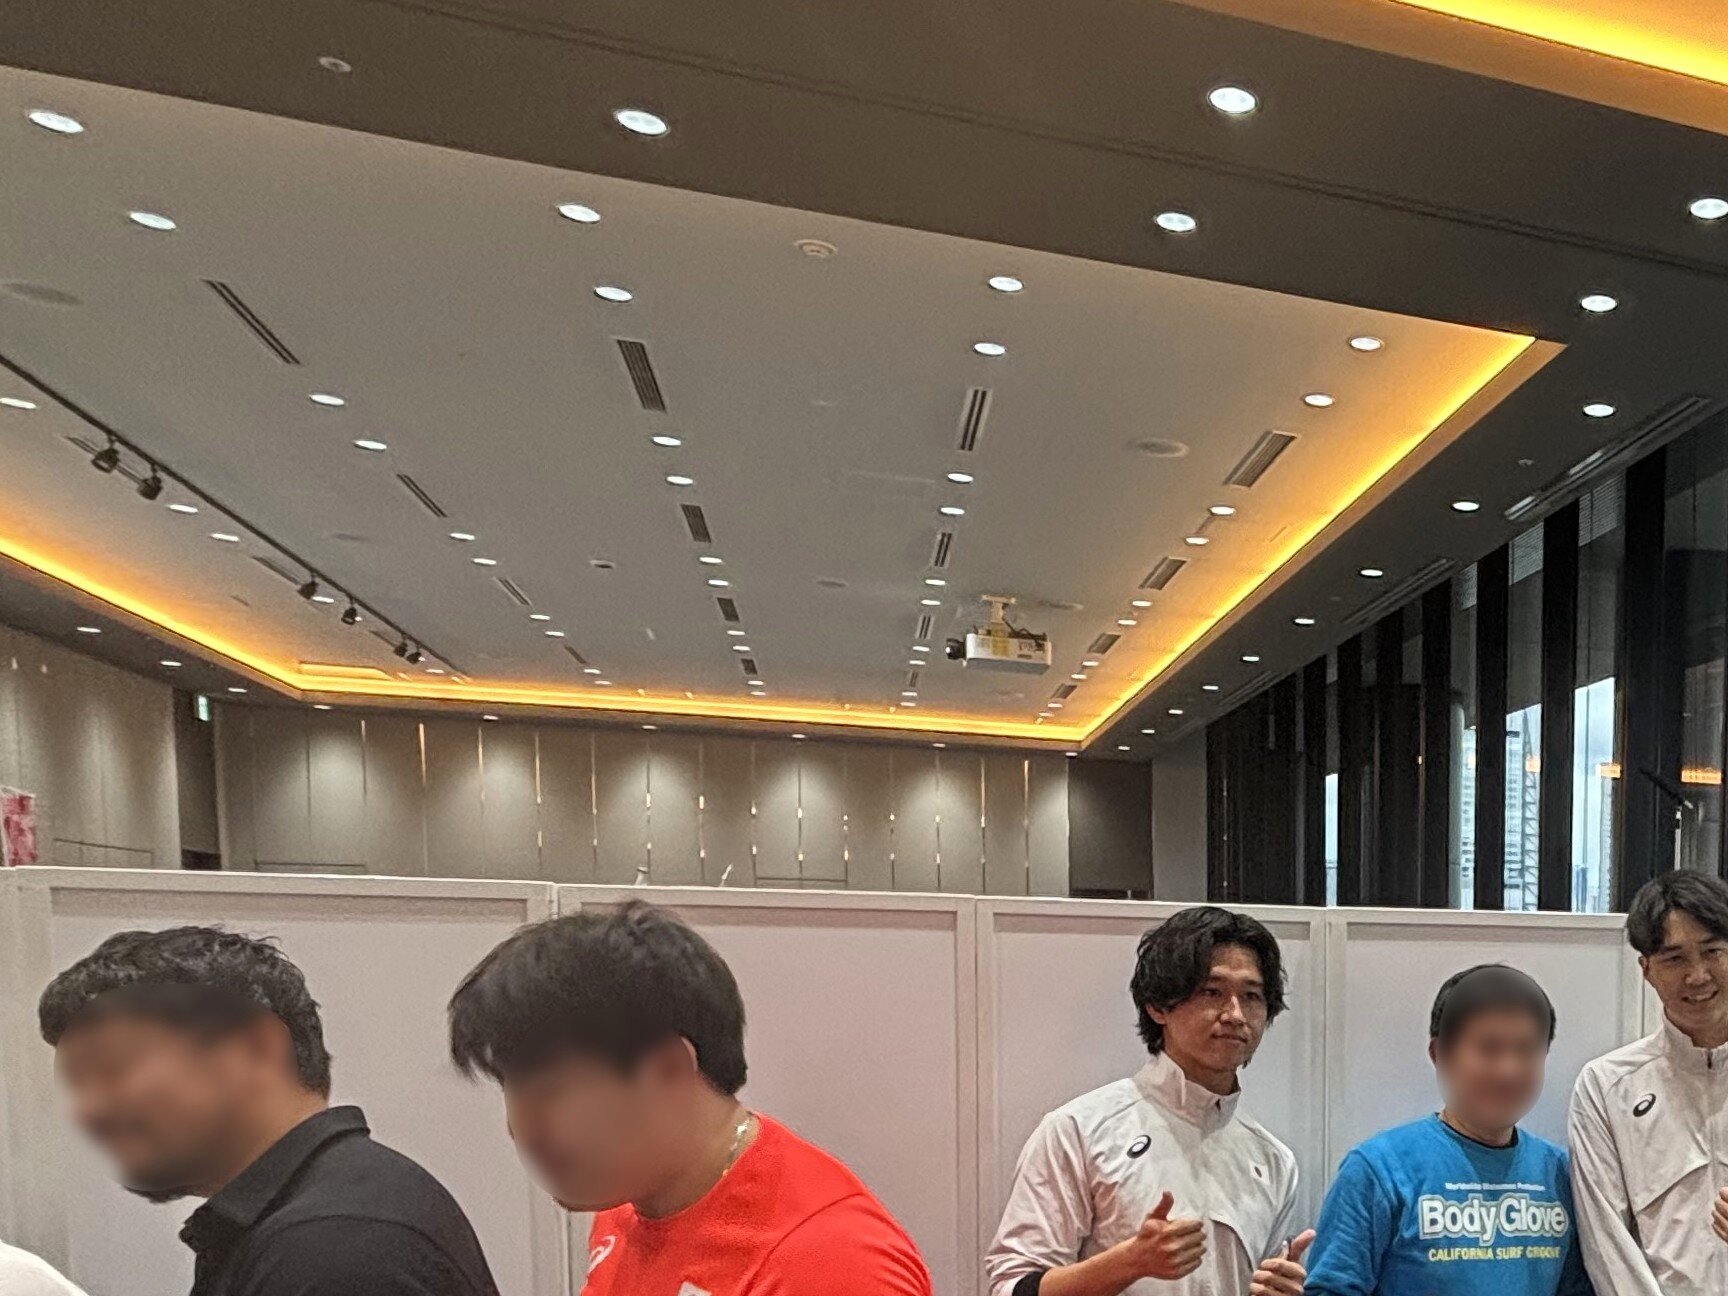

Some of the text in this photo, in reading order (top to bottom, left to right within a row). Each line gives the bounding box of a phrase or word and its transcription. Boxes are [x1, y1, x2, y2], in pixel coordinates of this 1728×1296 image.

[1422, 1197, 1567, 1242] Body Glove
[1428, 1245, 1494, 1262] CALIFORNIA
[1495, 1246, 1523, 1260] SURF
